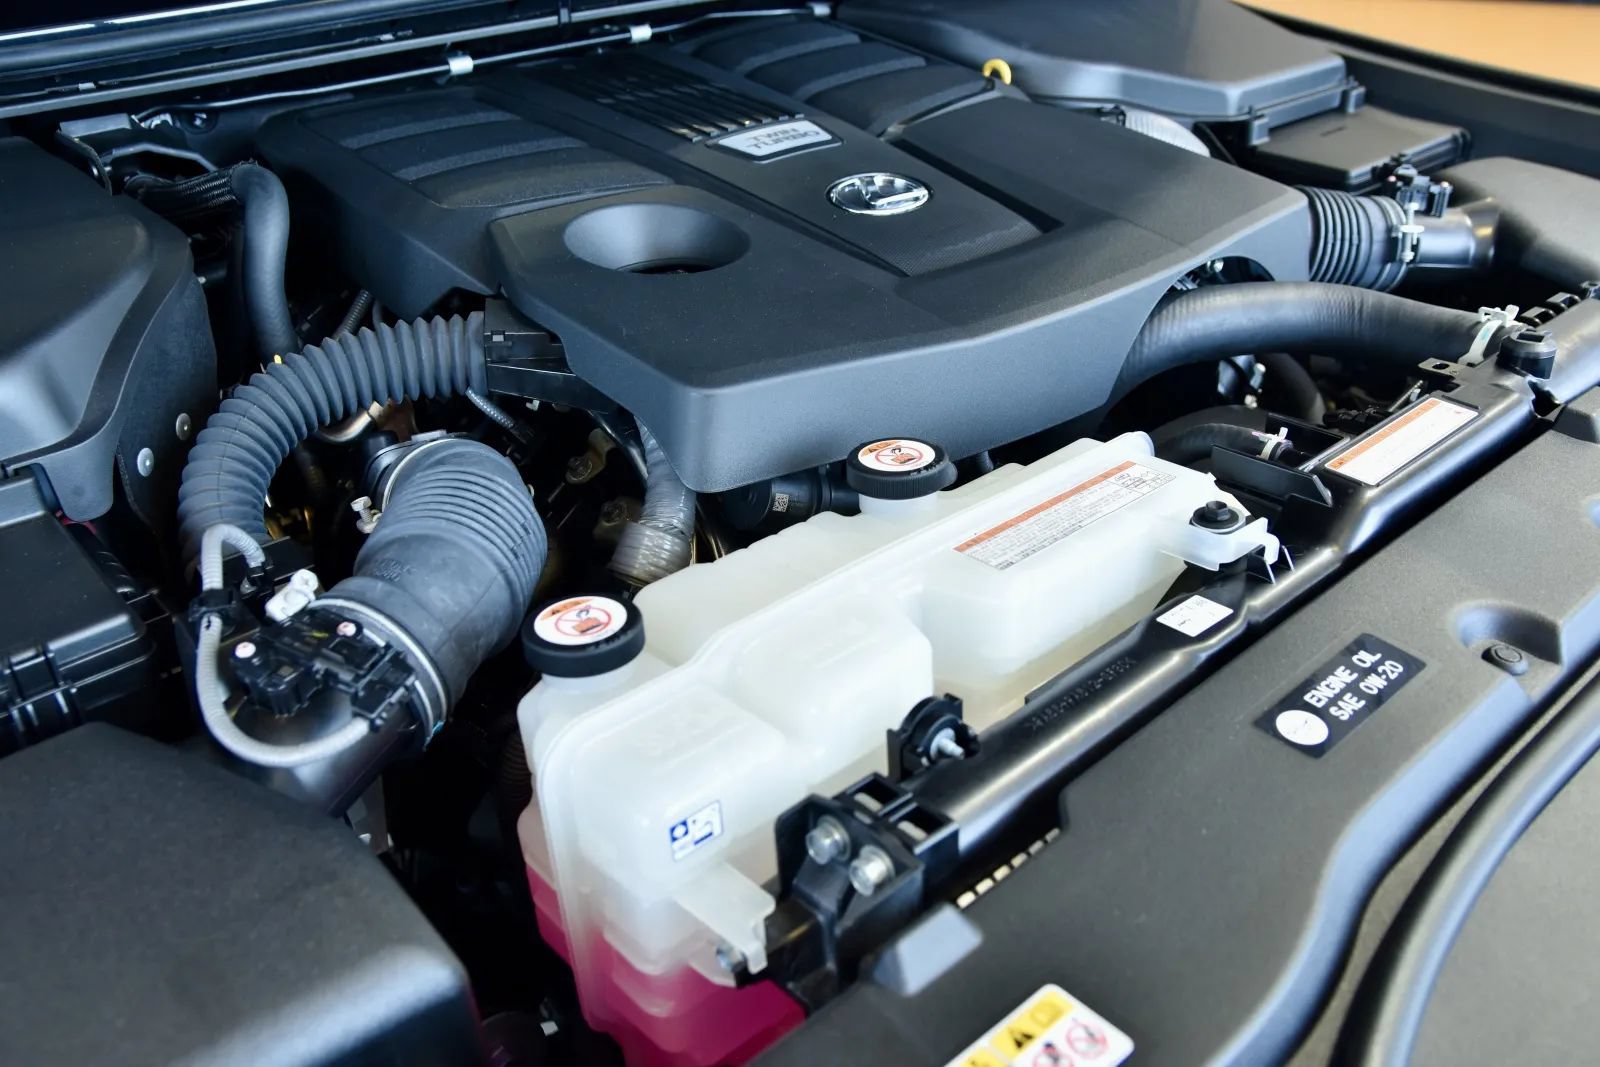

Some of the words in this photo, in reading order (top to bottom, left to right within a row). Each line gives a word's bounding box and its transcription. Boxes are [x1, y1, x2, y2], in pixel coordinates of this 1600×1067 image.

[745, 130, 820, 149] TURBO
[748, 127, 800, 141] TWIN
[1303, 665, 1359, 708] ENGINE
[1351, 649, 1383, 668] OIL
[1328, 692, 1367, 721] SAE
